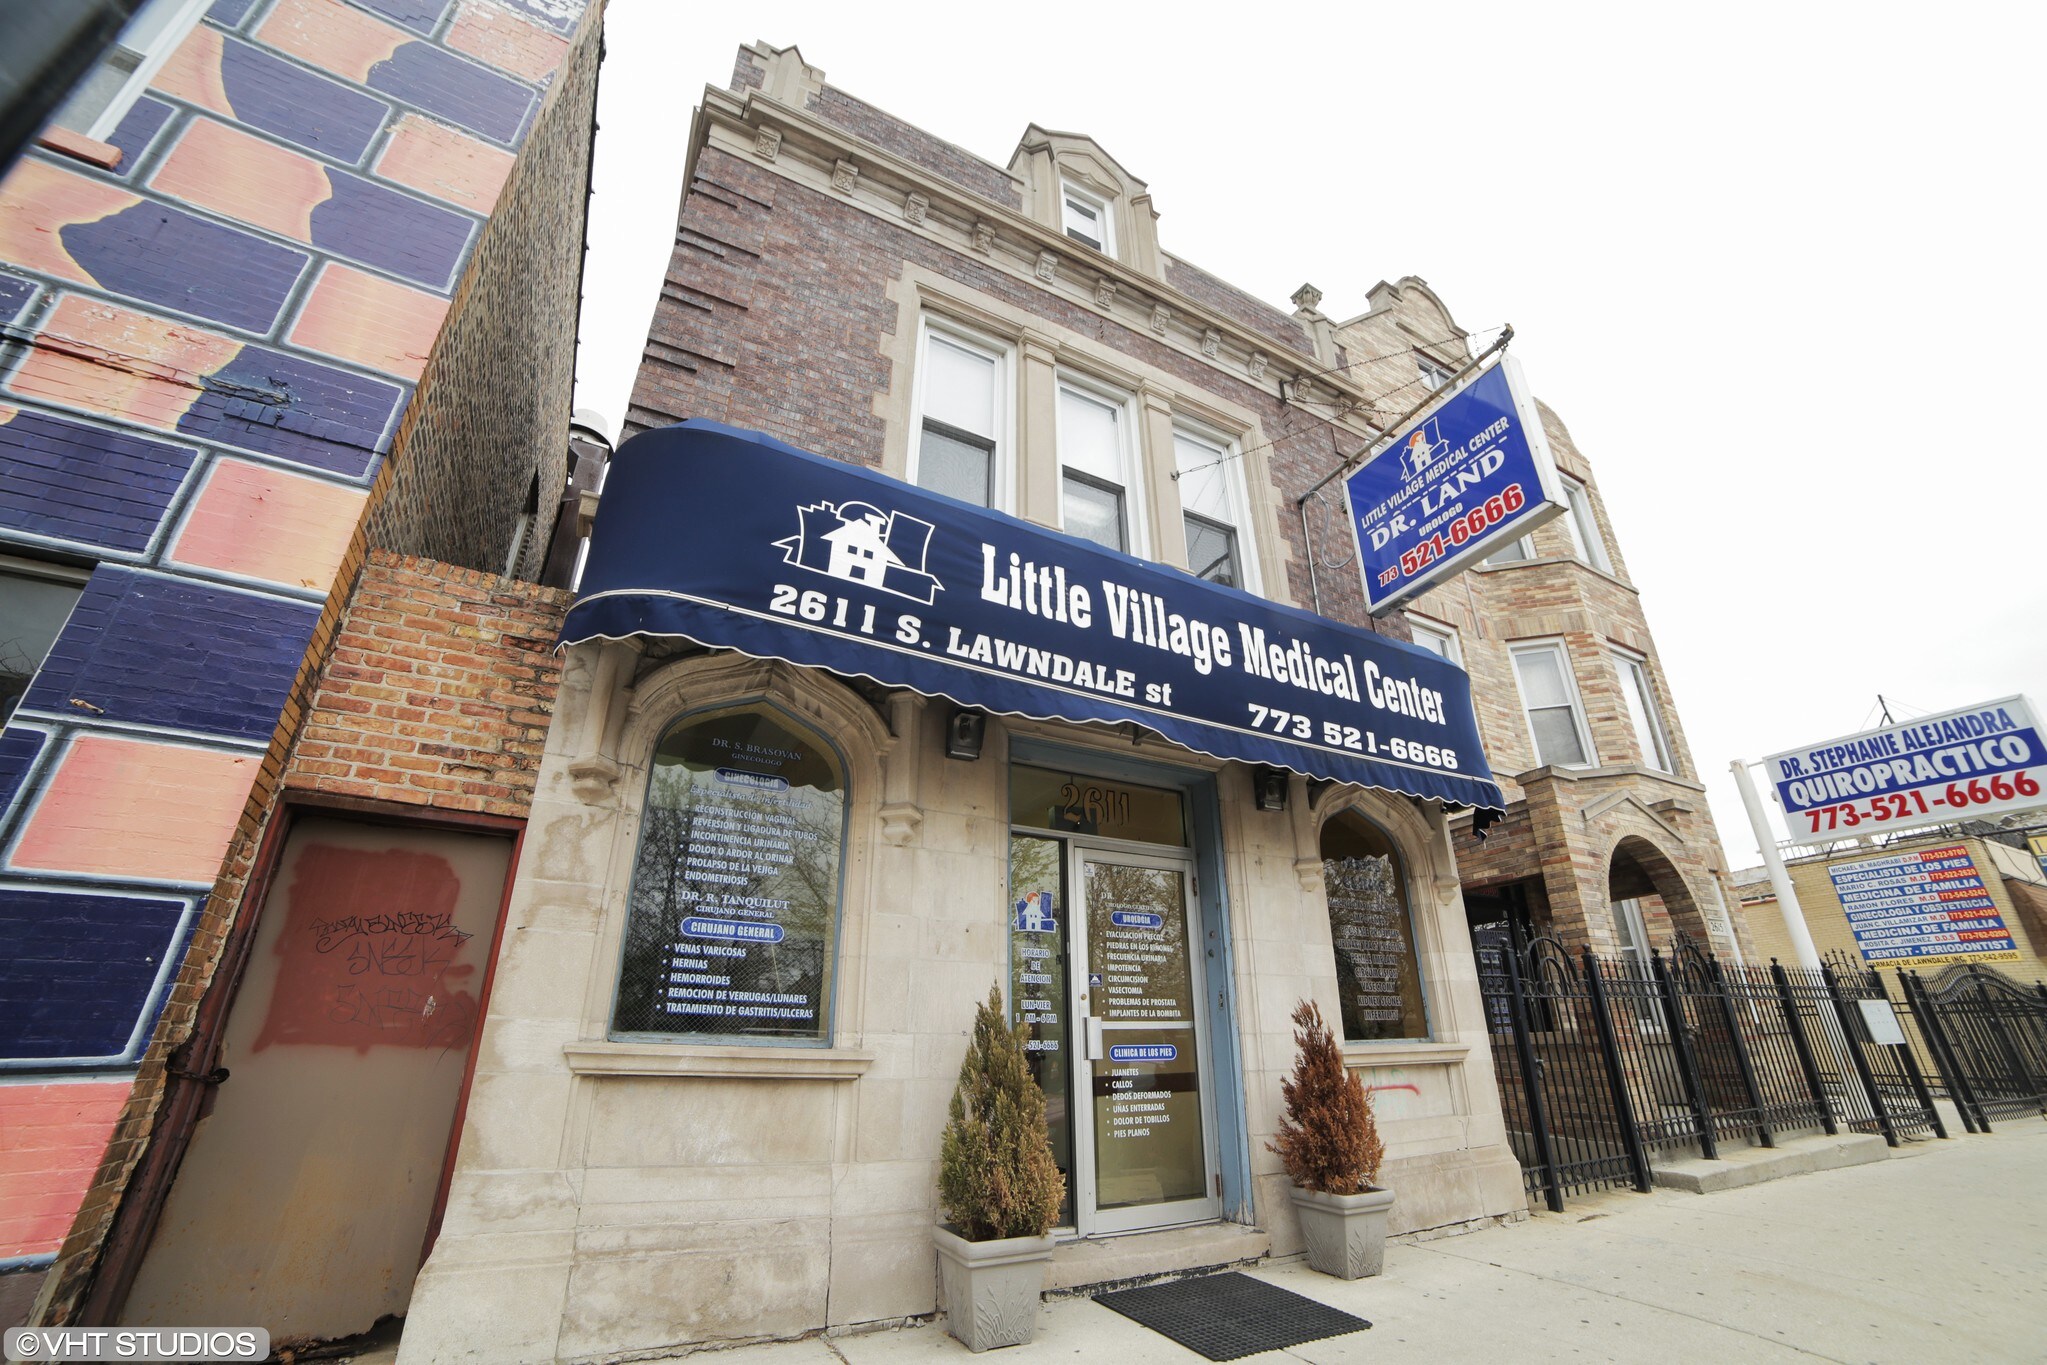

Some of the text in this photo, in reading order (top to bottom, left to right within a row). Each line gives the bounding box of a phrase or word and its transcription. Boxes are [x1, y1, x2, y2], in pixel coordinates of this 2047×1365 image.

[1361, 416, 1510, 529] LITTLE VILLAGE MEDICAL CENTER
[1370, 449, 1505, 552] DR. LAND
[1418, 502, 1463, 537] UROLOGO
[1378, 483, 1525, 588] 773 521-6666
[981, 542, 1446, 726] Little Village Medical Center
[769, 584, 1172, 707] 2611 S. LAWNDALE st
[1248, 703, 1458, 770] 773 521-6666
[1779, 708, 2017, 779] DR. STEPHANIE ALEJANDRA
[712, 738, 802, 761] DR. S. BRASOVAN
[732, 753, 782, 767] GINECOLOGO
[1788, 735, 2032, 808] QUIROPRACTICO
[724, 771, 779, 789] GINECOLOGIA
[690, 784, 746, 801] Especialista
[1061, 783, 1130, 826] 2611
[1804, 771, 2041, 833] 773-521-6666
[764, 813, 796, 825] VAGINAL
[692, 817, 818, 841] REVERSIÓN Y LIGADURA DE TUBOS
[690, 830, 790, 851] INCONTINENCIA URINARIA
[688, 843, 795, 864] DOLOR O ARDOR AL ORINAR
[686, 857, 779, 876] PROLAPSO DE LA VEJIGA
[1831, 865, 1857, 874] MICHAEL
[1835, 858, 1969, 884] ESPECIALISTA DE LOS PIES
[684, 871, 749, 886] ENDOMETRIOSIS
[1839, 883, 1865, 892] MARIO
[1878, 878, 1907, 887] ROSAS
[1843, 878, 1980, 903] MEDICINA DE FAMILIA
[681, 891, 790, 910] DR. R. TANQUILUT
[1847, 903, 1878, 911] RAMON
[1880, 897, 1915, 907] FLORES
[695, 905, 775, 919] CIRUJANO GENERAL
[1850, 898, 1992, 921] GINECOLOGIA Y OBSTETRICIA
[690, 921, 775, 939] CIRUJANO GENERAL
[1855, 922, 1874, 930] JUAN
[1882, 916, 1928, 927] VILLAMIZAR
[1861, 918, 1999, 940] MEDICINA DE FAMILIA
[1143, 933, 1164, 941] PRECOZ
[1864, 940, 1889, 948] ROSITA
[1900, 936, 1932, 945] JIMENEZ
[674, 943, 747, 958] VENAS VARICOSAS
[1021, 948, 1050, 958] HORARIO
[1106, 942, 1129, 950] PIEDRAS
[1867, 947, 1913, 959] DENTIST
[1921, 940, 2008, 955] PERIODONTIST
[672, 957, 709, 969] HERNIAS
[1106, 953, 1140, 961] FRECUENCIA
[1912, 956, 1949, 966] LAWNDALE
[1967, 951, 2018, 963] 773-542-9595
[1031, 961, 1040, 971] DE
[1107, 964, 1141, 972] IMPOTENCIA
[670, 972, 731, 985] HEMORROIDES
[1020, 973, 1052, 983] ATENCION
[668, 987, 808, 1004] REMOCION DE VERRUGAS/LUNARES
[1108, 986, 1143, 995] VASECTOMIA
[1108, 998, 1177, 1006] PROBLEMAS DE PROSTATA
[666, 1002, 814, 1019] TRATAMIENTO DE GASTRITIS/ULCERAS
[1109, 1009, 1140, 1017] IMPLANTES
[1140, 1009, 1148, 1017] DE
[1149, 1009, 1156, 1017] LA
[1114, 1048, 1173, 1057] CLINICA DE LOS PIES
[1111, 1068, 1139, 1077] JUANETES
[1112, 1081, 1133, 1089] CALLOS
[1112, 1091, 1171, 1101] DEDOS DEFORMADOS
[1113, 1103, 1165, 1113] UÑAS ENTERRADAS
[1113, 1115, 1170, 1126] DOLOR DE TOBILLOS
[1114, 1128, 1150, 1138] PIES PLANOS
